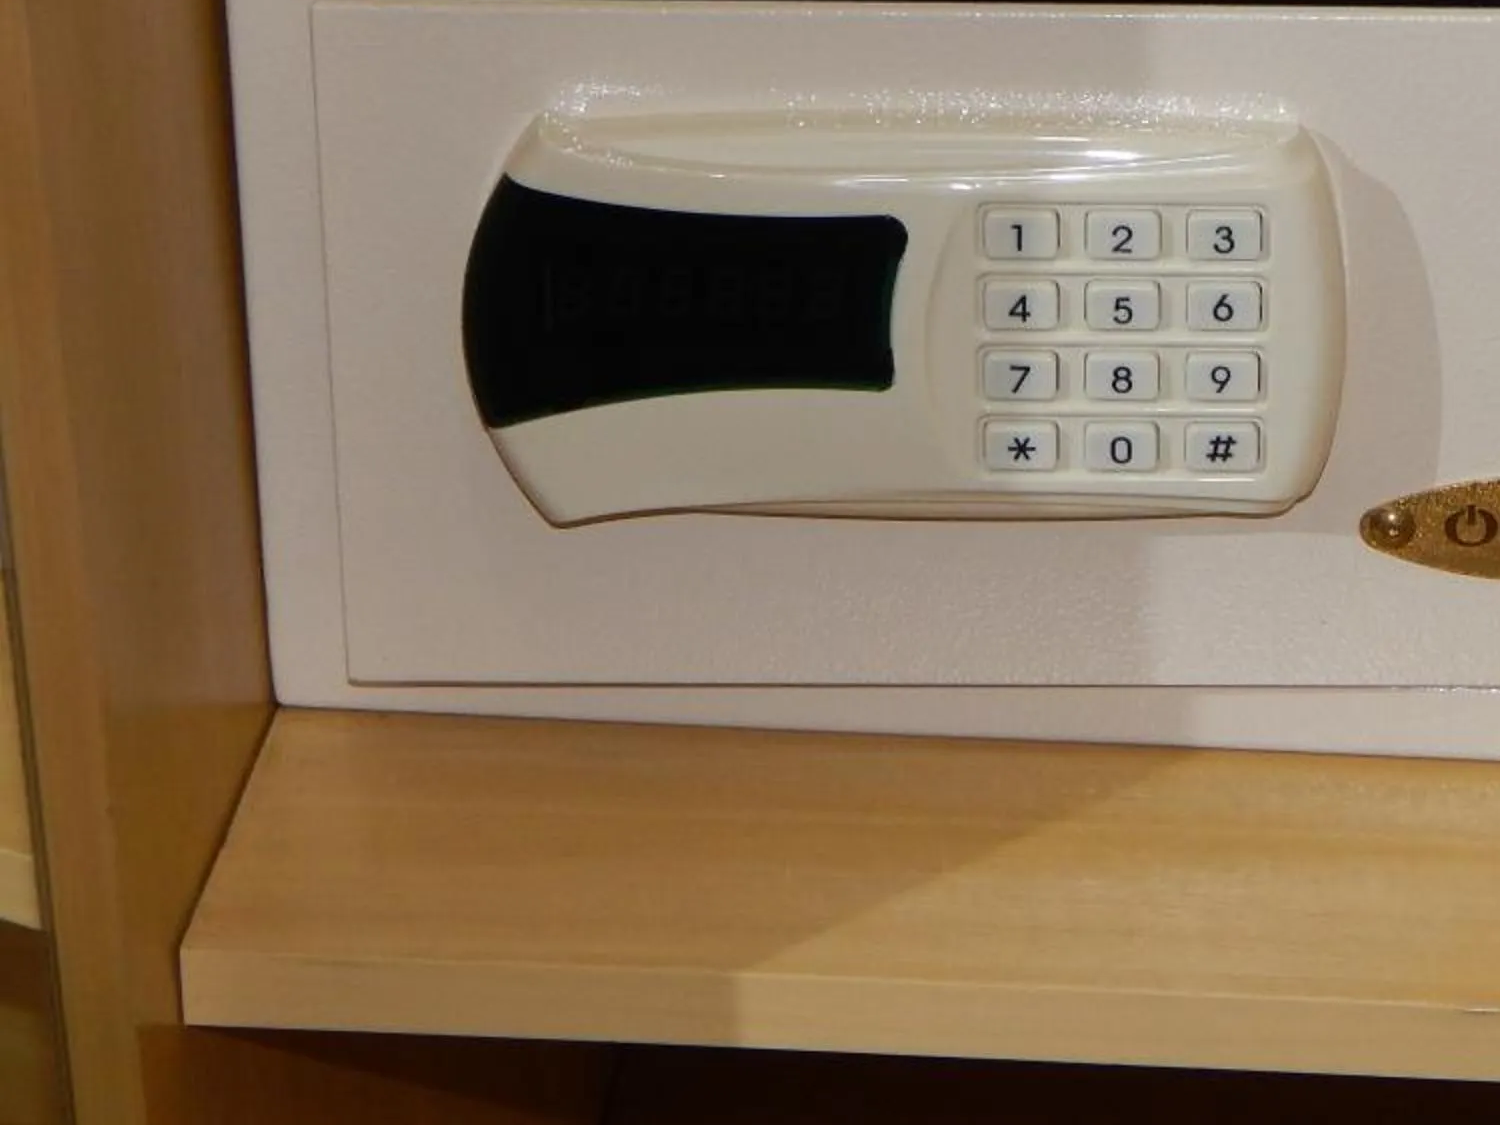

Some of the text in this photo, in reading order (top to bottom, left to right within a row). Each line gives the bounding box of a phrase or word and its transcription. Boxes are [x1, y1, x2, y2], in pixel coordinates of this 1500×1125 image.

[1011, 225, 1235, 254] 1 2 3
[1008, 294, 1234, 324] 4 5 6
[1009, 366, 1231, 394] 7 8 9
[1110, 437, 1132, 464] 0
[1206, 436, 1236, 462] #
